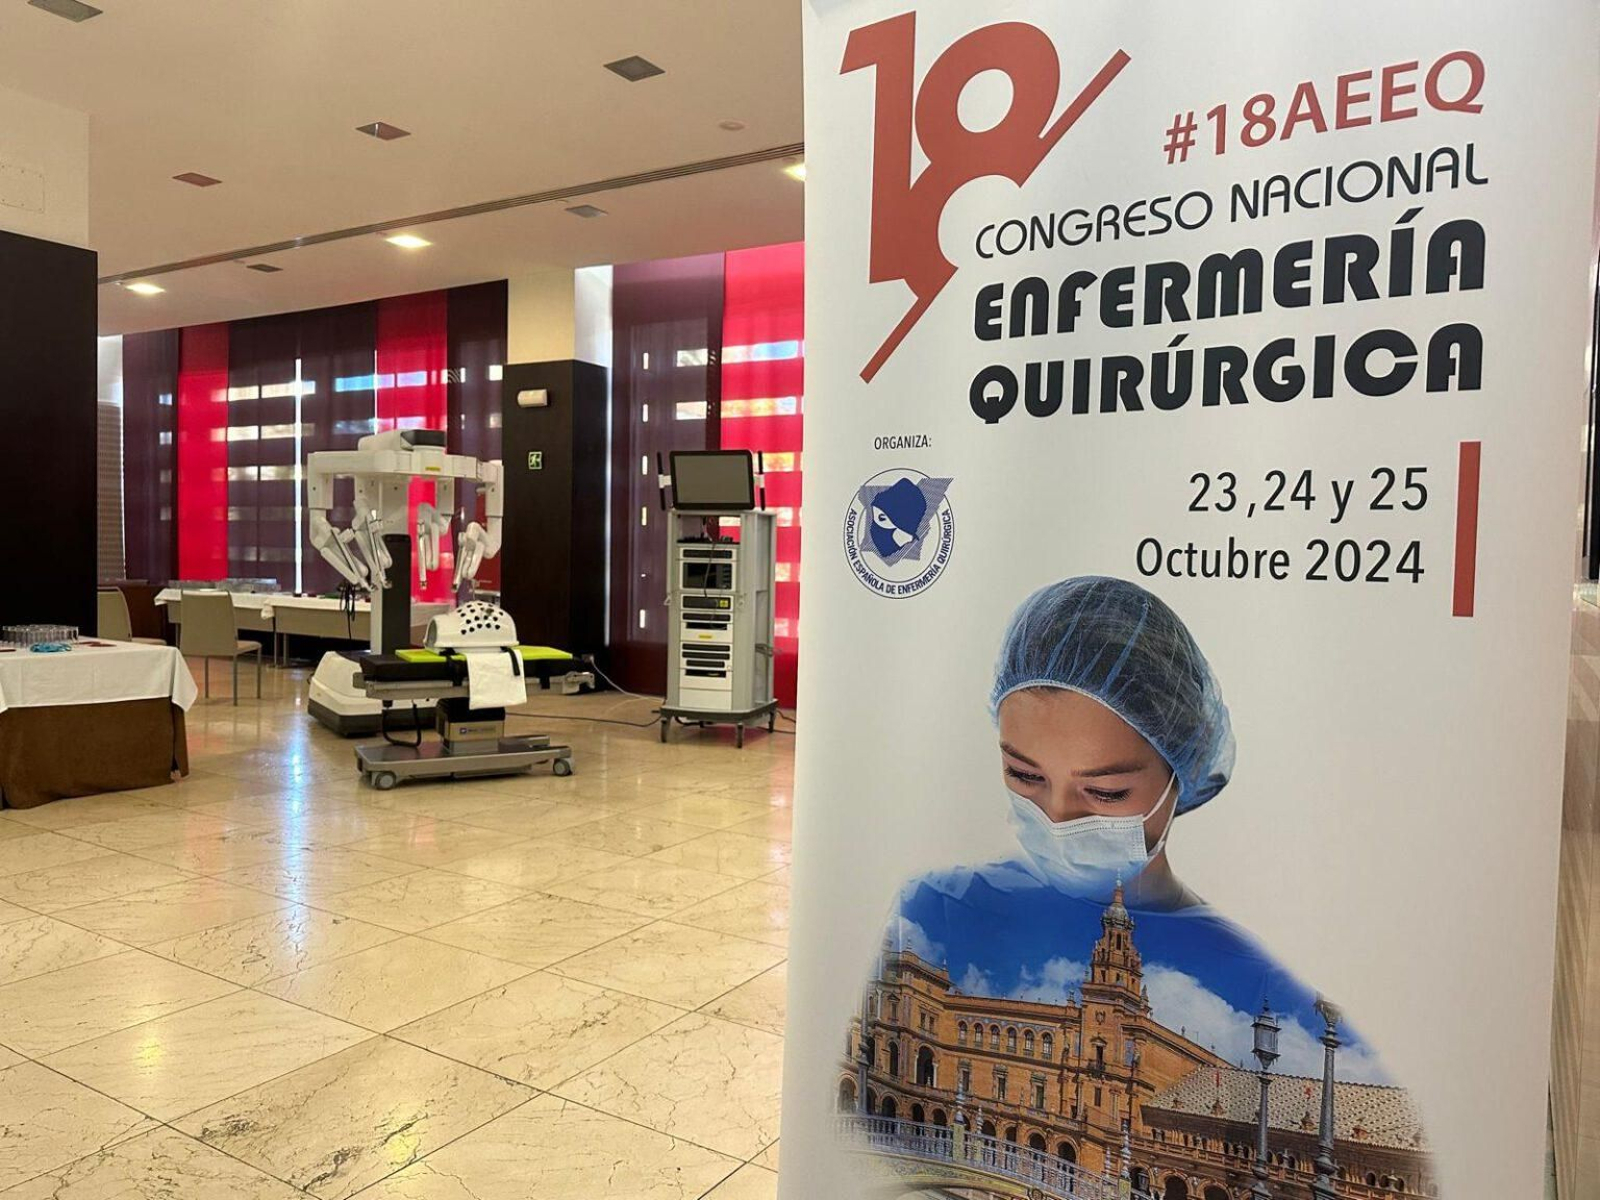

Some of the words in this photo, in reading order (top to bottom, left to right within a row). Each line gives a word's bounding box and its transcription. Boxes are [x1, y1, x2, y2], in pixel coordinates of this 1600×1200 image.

[1164, 51, 1485, 164] #18AEEQ
[975, 191, 1213, 259] CONGRESO
[1230, 142, 1489, 223] NACIONAL
[974, 206, 1487, 342] ENFERMERÍA
[969, 322, 1484, 425] QUIRÚRGICA
[874, 434, 932, 450] ORGANIZA:
[1330, 480, 1355, 524] y
[1369, 466, 1428, 511] 25
[846, 508, 858, 561] ASOCIACIÓN
[853, 559, 884, 594] ESPAÑOLA
[886, 584, 896, 595] DE
[898, 564, 941, 595] ENFERMERÍA
[936, 508, 952, 565] QUIRÚRGICA
[1136, 536, 1291, 581] Octubre
[1304, 538, 1425, 584] 2024
